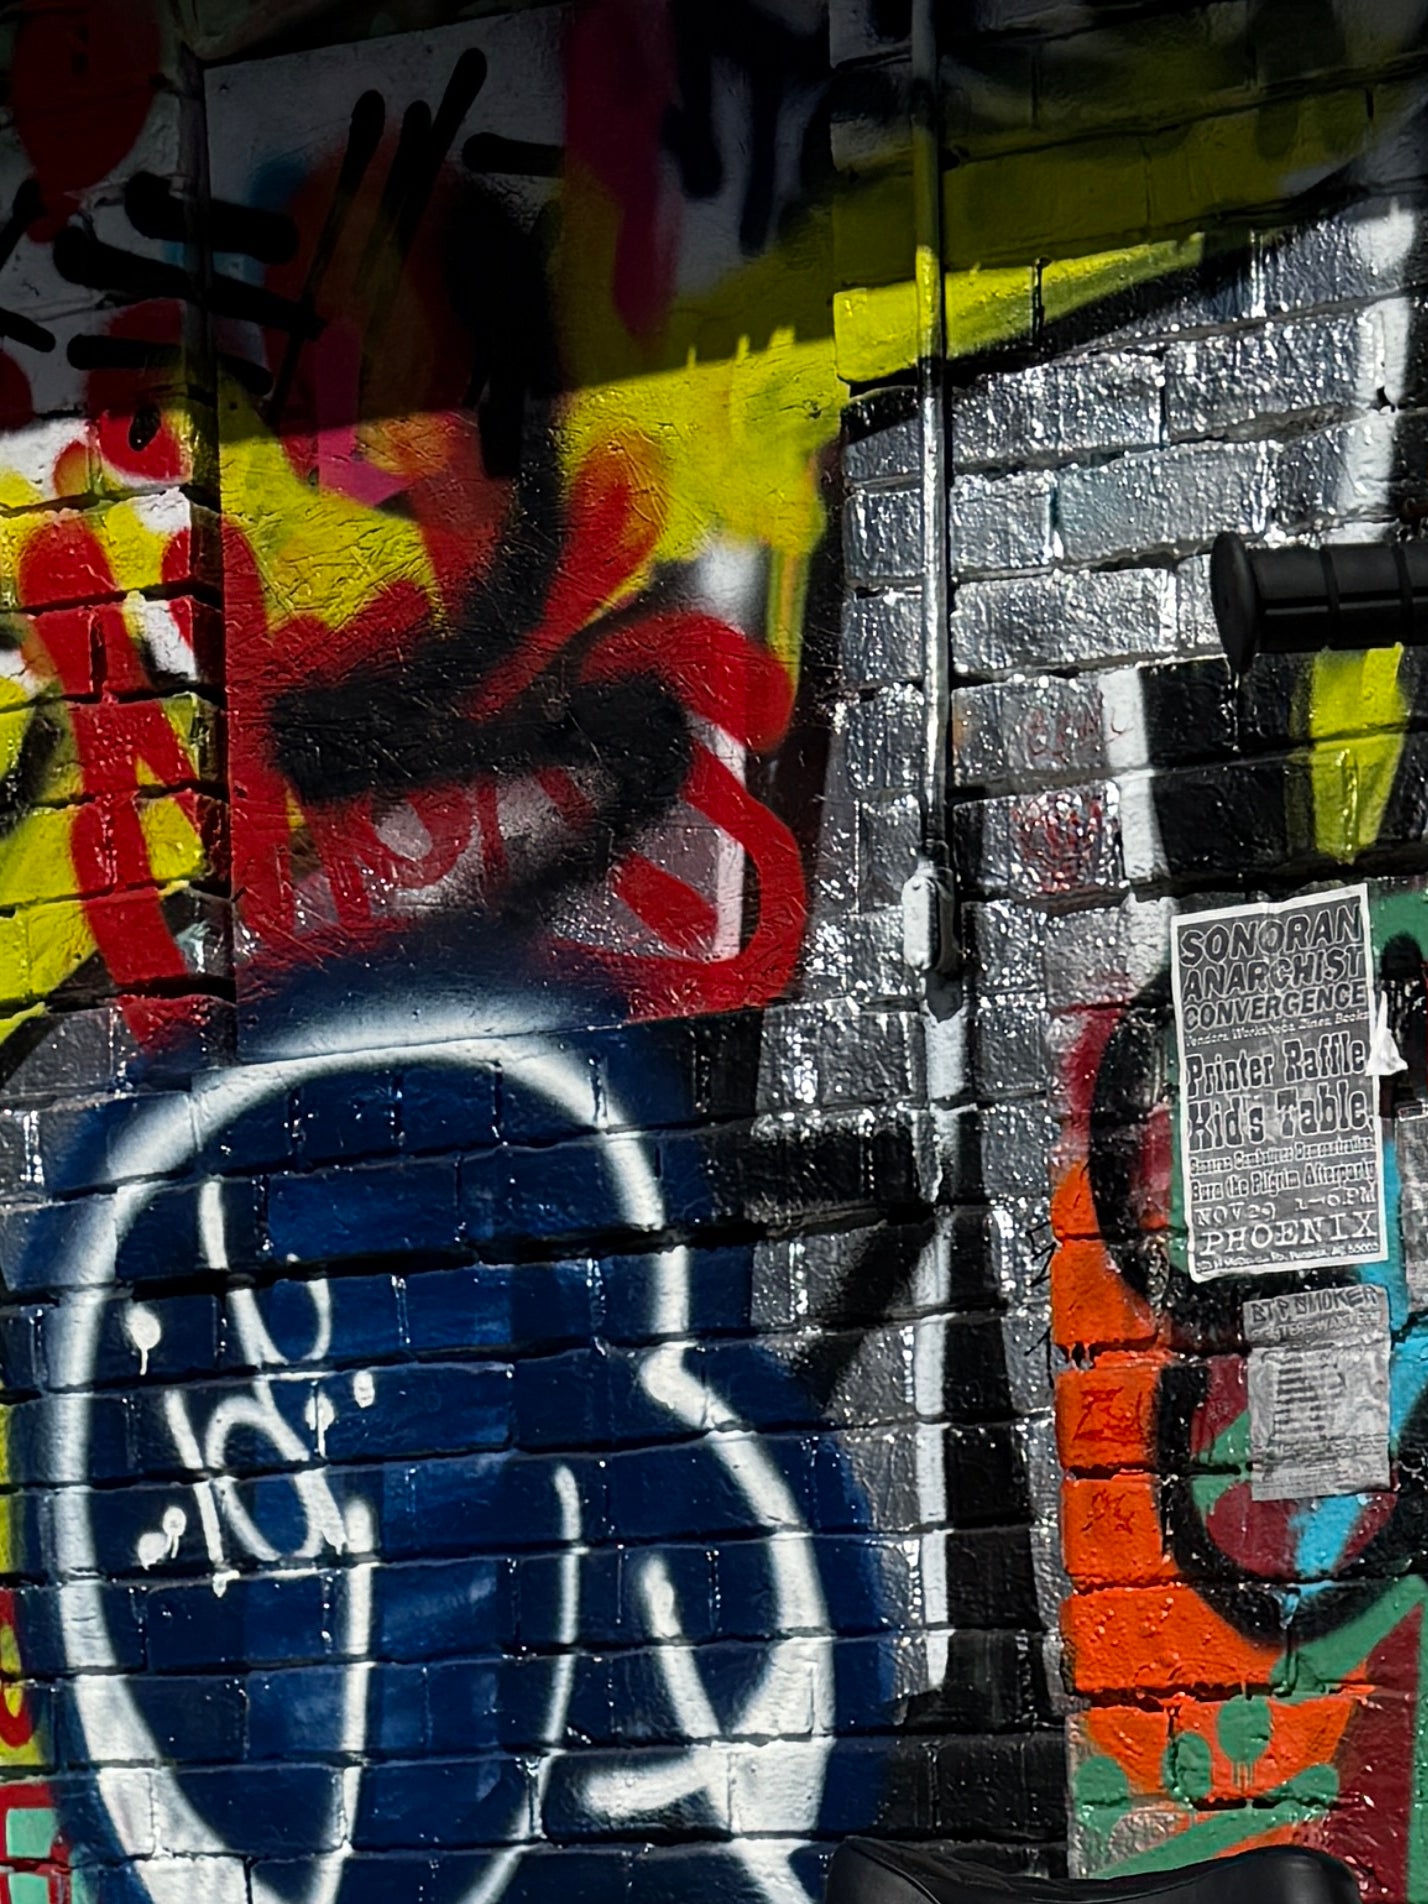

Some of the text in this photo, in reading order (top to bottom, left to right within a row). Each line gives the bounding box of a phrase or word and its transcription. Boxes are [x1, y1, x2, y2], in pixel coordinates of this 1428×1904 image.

[1180, 903, 1362, 967] SONORAN
[1183, 945, 1364, 1003] ANARCHIST
[1183, 977, 1367, 1032] CONVERGENCE
[1185, 1031, 1365, 1097] Printer Raffle
[1226, 1174, 1248, 1197] the
[1251, 1168, 1300, 1197] Pilgrim
[1304, 1158, 1376, 1187] Afterparty
[1200, 1210, 1378, 1256] PHOENIX
[1295, 1285, 1377, 1315] SMOKER
